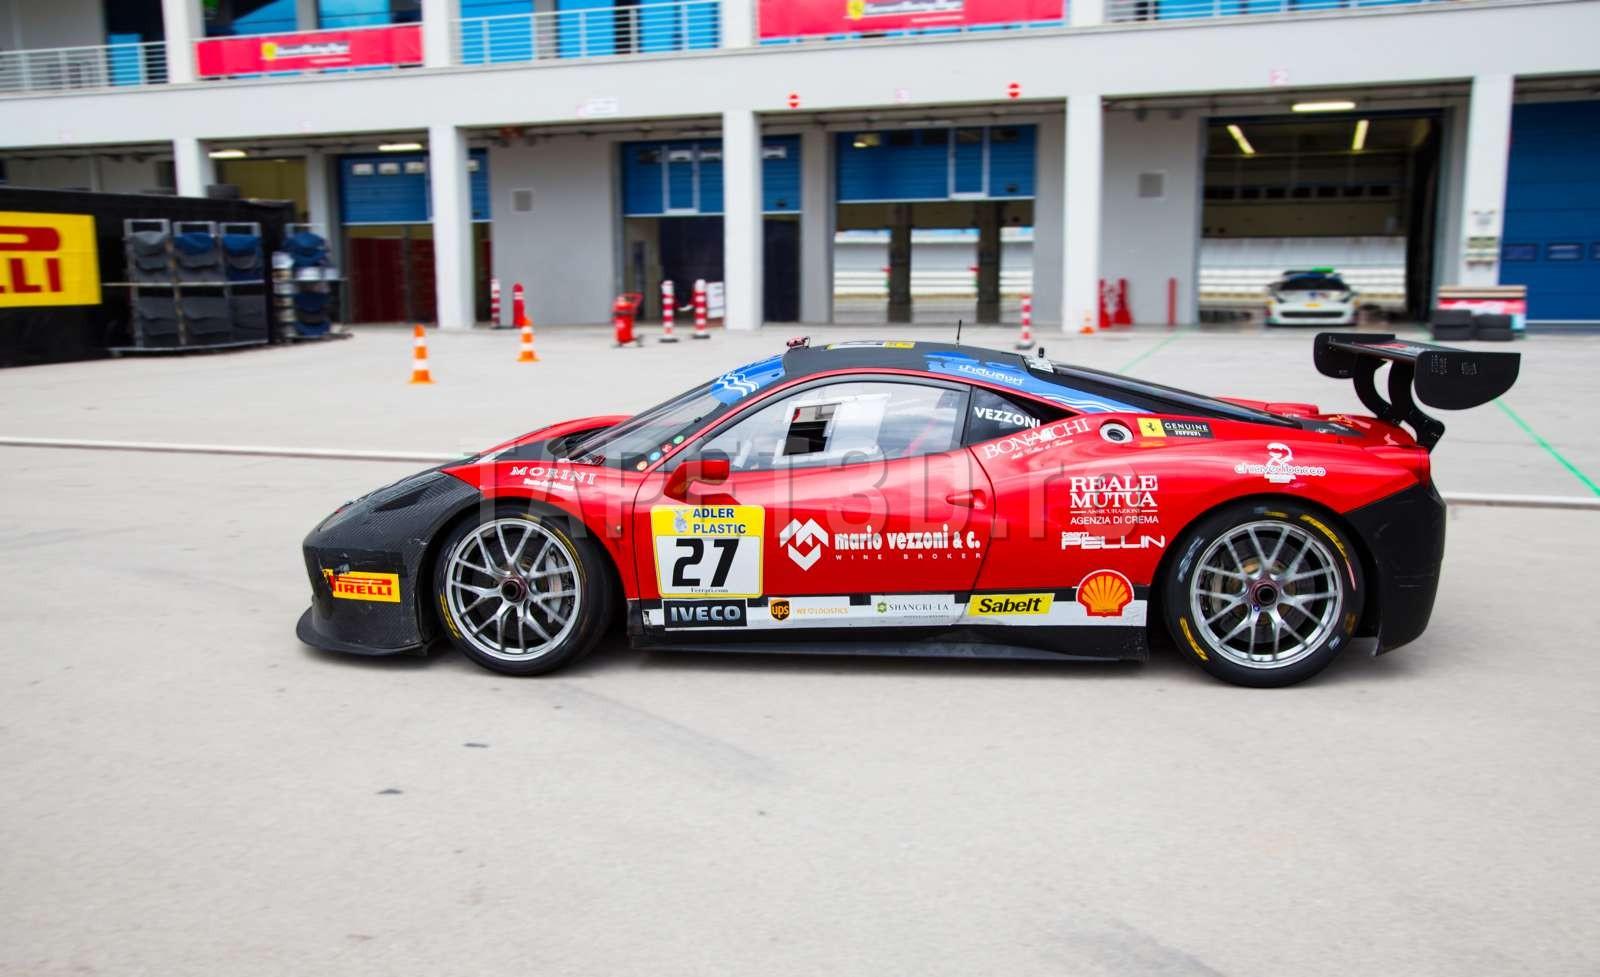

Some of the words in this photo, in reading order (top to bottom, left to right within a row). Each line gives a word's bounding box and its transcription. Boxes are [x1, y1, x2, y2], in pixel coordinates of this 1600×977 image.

[974, 406, 1041, 429] VEZZONI
[1164, 422, 1209, 432] GENUINE
[510, 466, 597, 485] MORINI
[1069, 475, 1158, 492] REALE
[1069, 491, 1158, 508] MUTUA
[692, 508, 735, 518] ADLER
[1070, 516, 1111, 524] AGENZIA
[1113, 516, 1123, 524] DI
[1124, 515, 1159, 524] CREMA
[692, 523, 747, 534] PLASTIC
[834, 525, 883, 550] mario
[887, 523, 949, 549] vezzoni
[953, 530, 963, 549] &
[1061, 534, 1165, 550] PELLIN
[672, 538, 740, 587] 27
[889, 602, 949, 611] SHANGRI-LA
[978, 597, 1042, 613] Sabelt
[670, 605, 741, 622] IVECO
